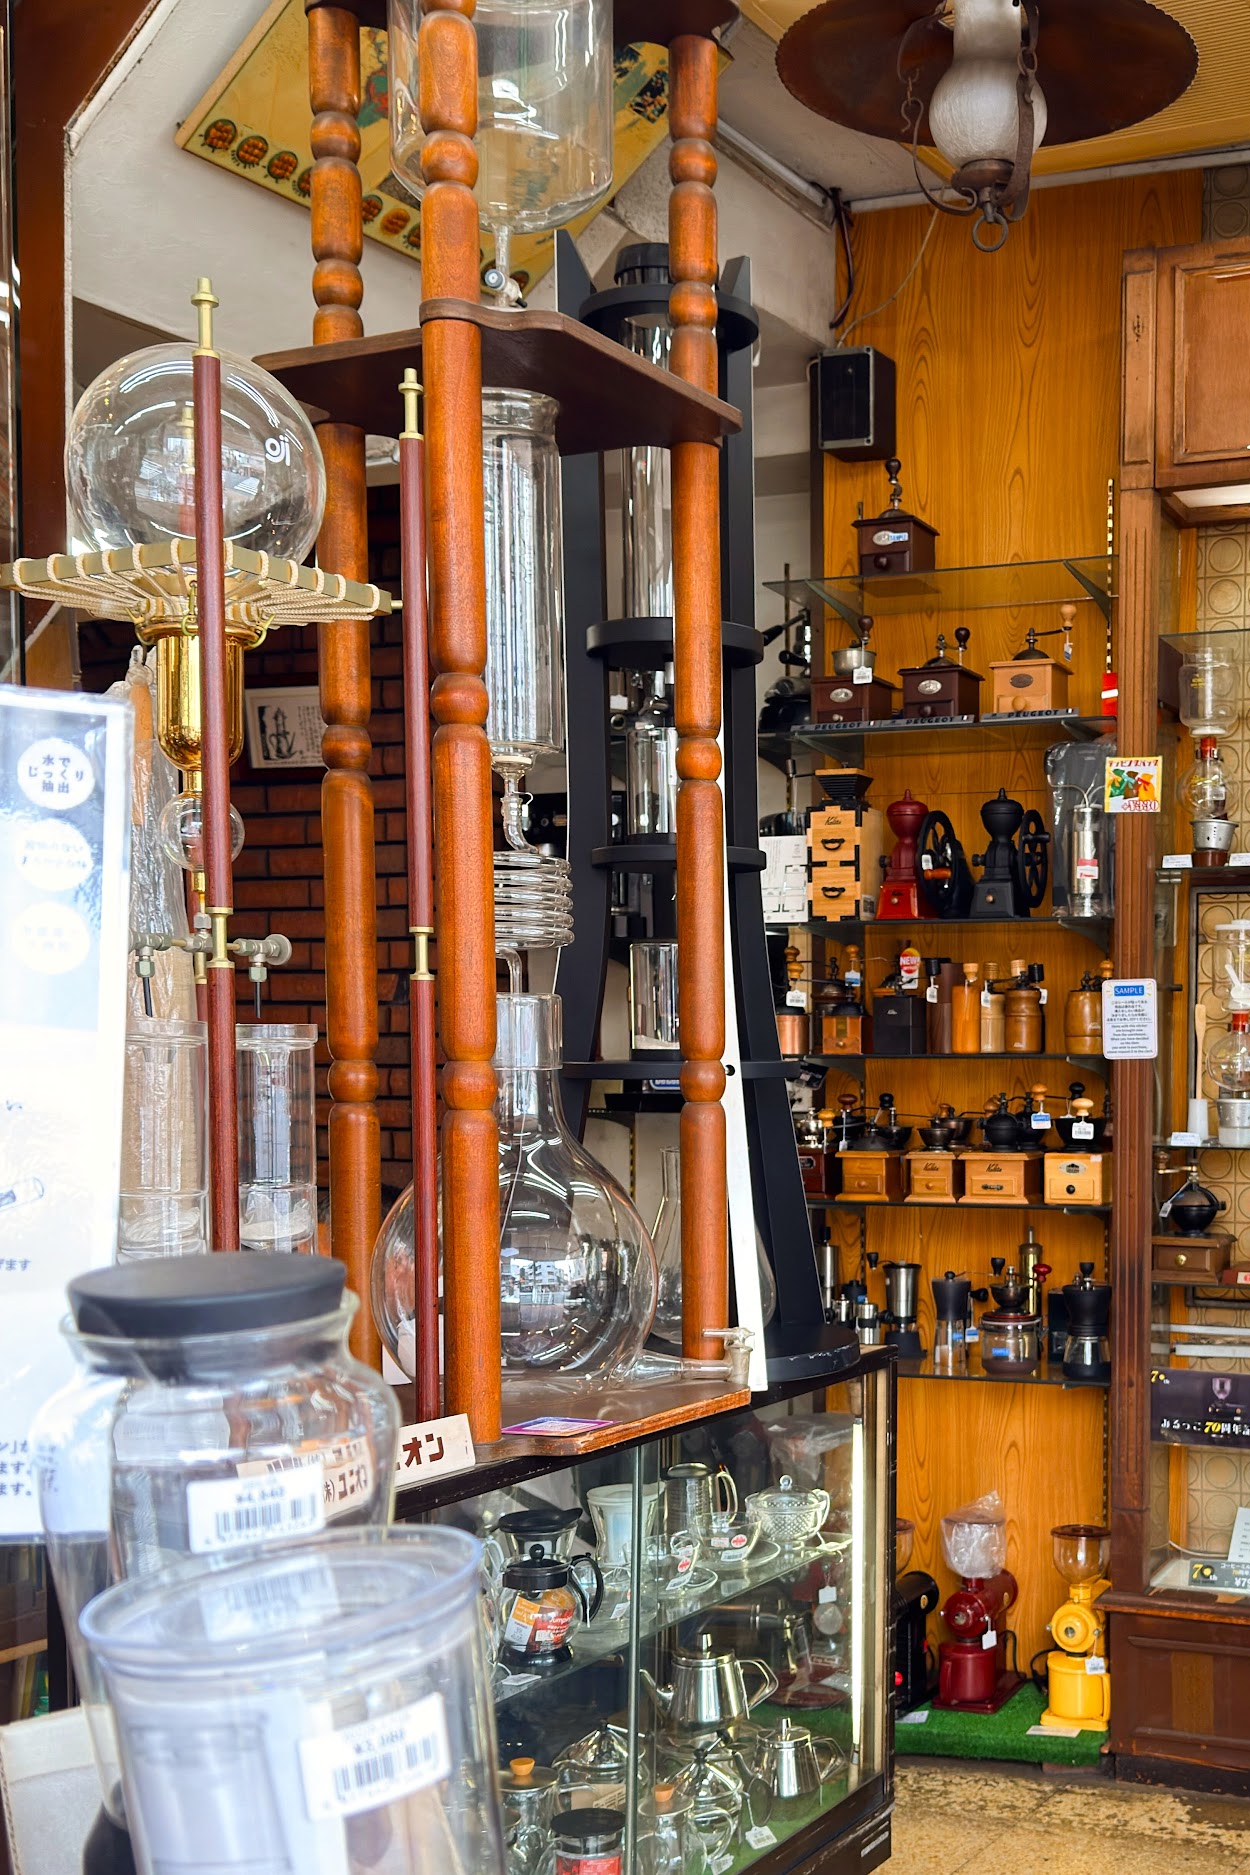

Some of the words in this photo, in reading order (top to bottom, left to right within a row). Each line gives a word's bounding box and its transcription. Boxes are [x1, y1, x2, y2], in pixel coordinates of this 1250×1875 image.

[1007, 709, 1059, 718] PEUGEOT
[905, 715, 955, 725] PEUGEOT
[814, 721, 862, 731] PEUGEOT
[398, 1432, 444, 1471] オン
